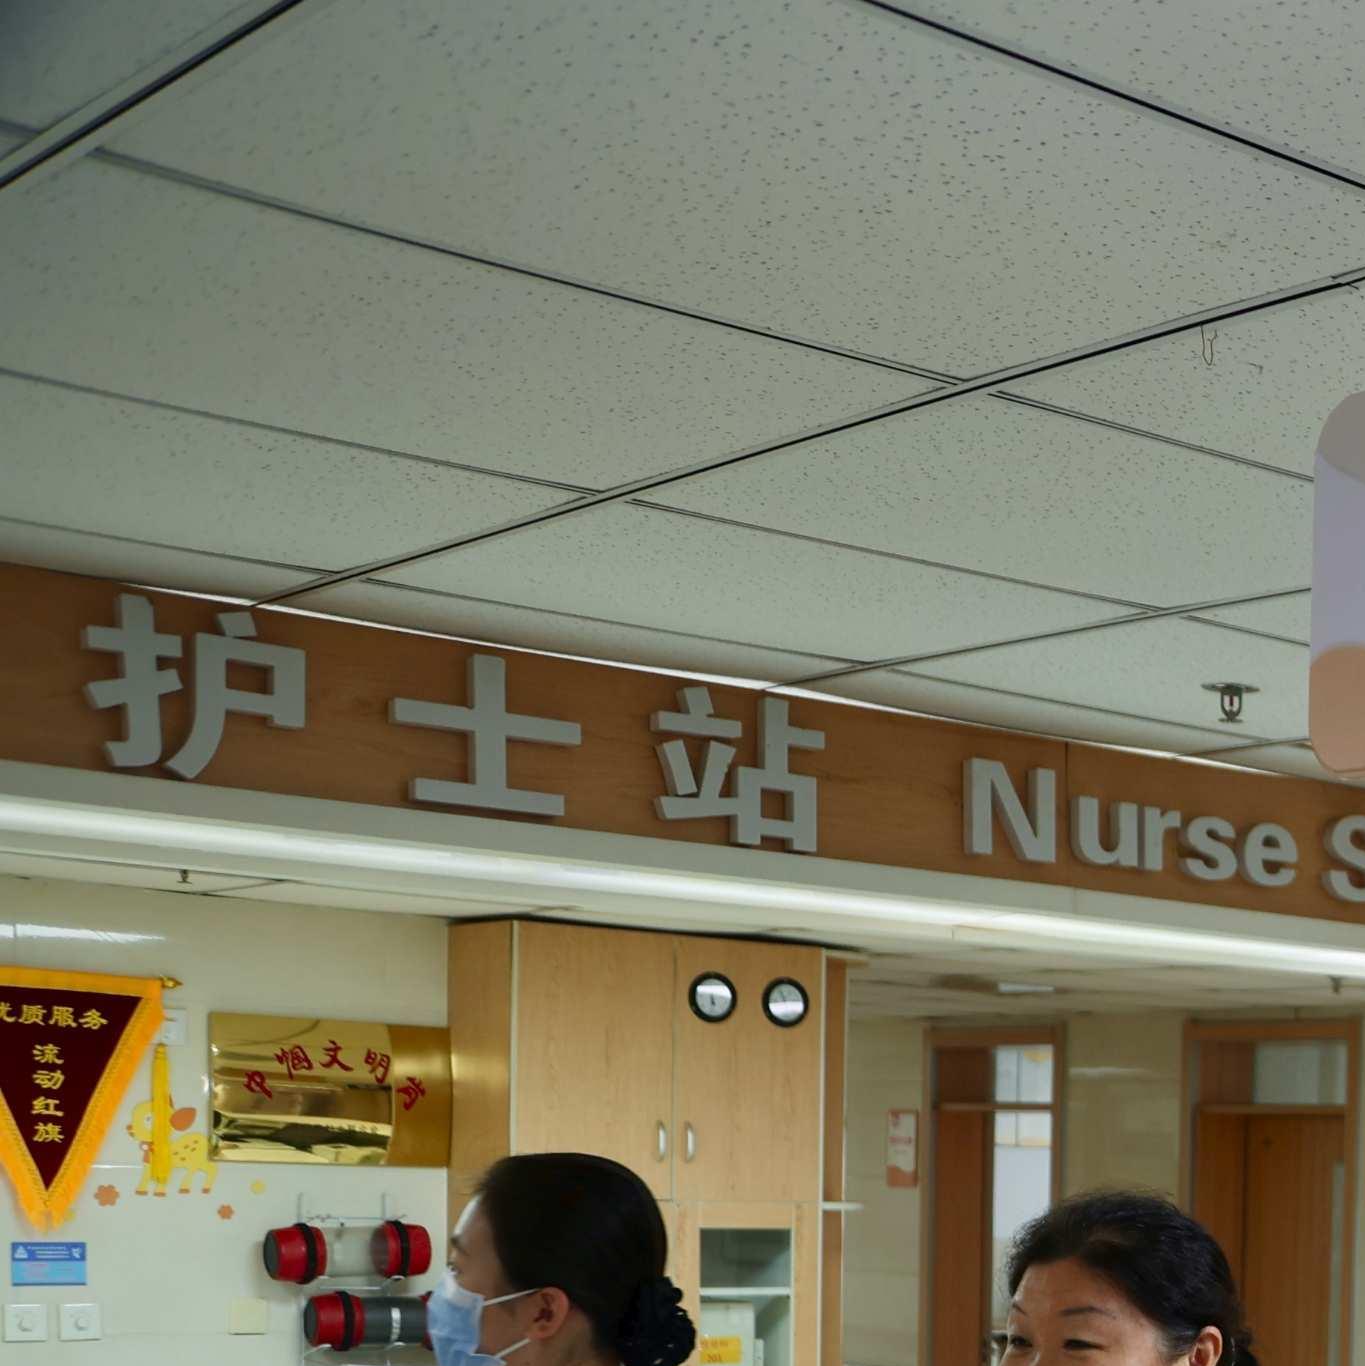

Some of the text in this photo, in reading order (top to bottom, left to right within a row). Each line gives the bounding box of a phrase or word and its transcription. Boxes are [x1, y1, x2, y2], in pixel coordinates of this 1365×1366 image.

[81, 592, 826, 852] 护士站
[962, 757, 1298, 887] Nurse
[30, 1042, 66, 1143] 流动红旗
[244, 1039, 426, 1111] 巾帼文明岗
